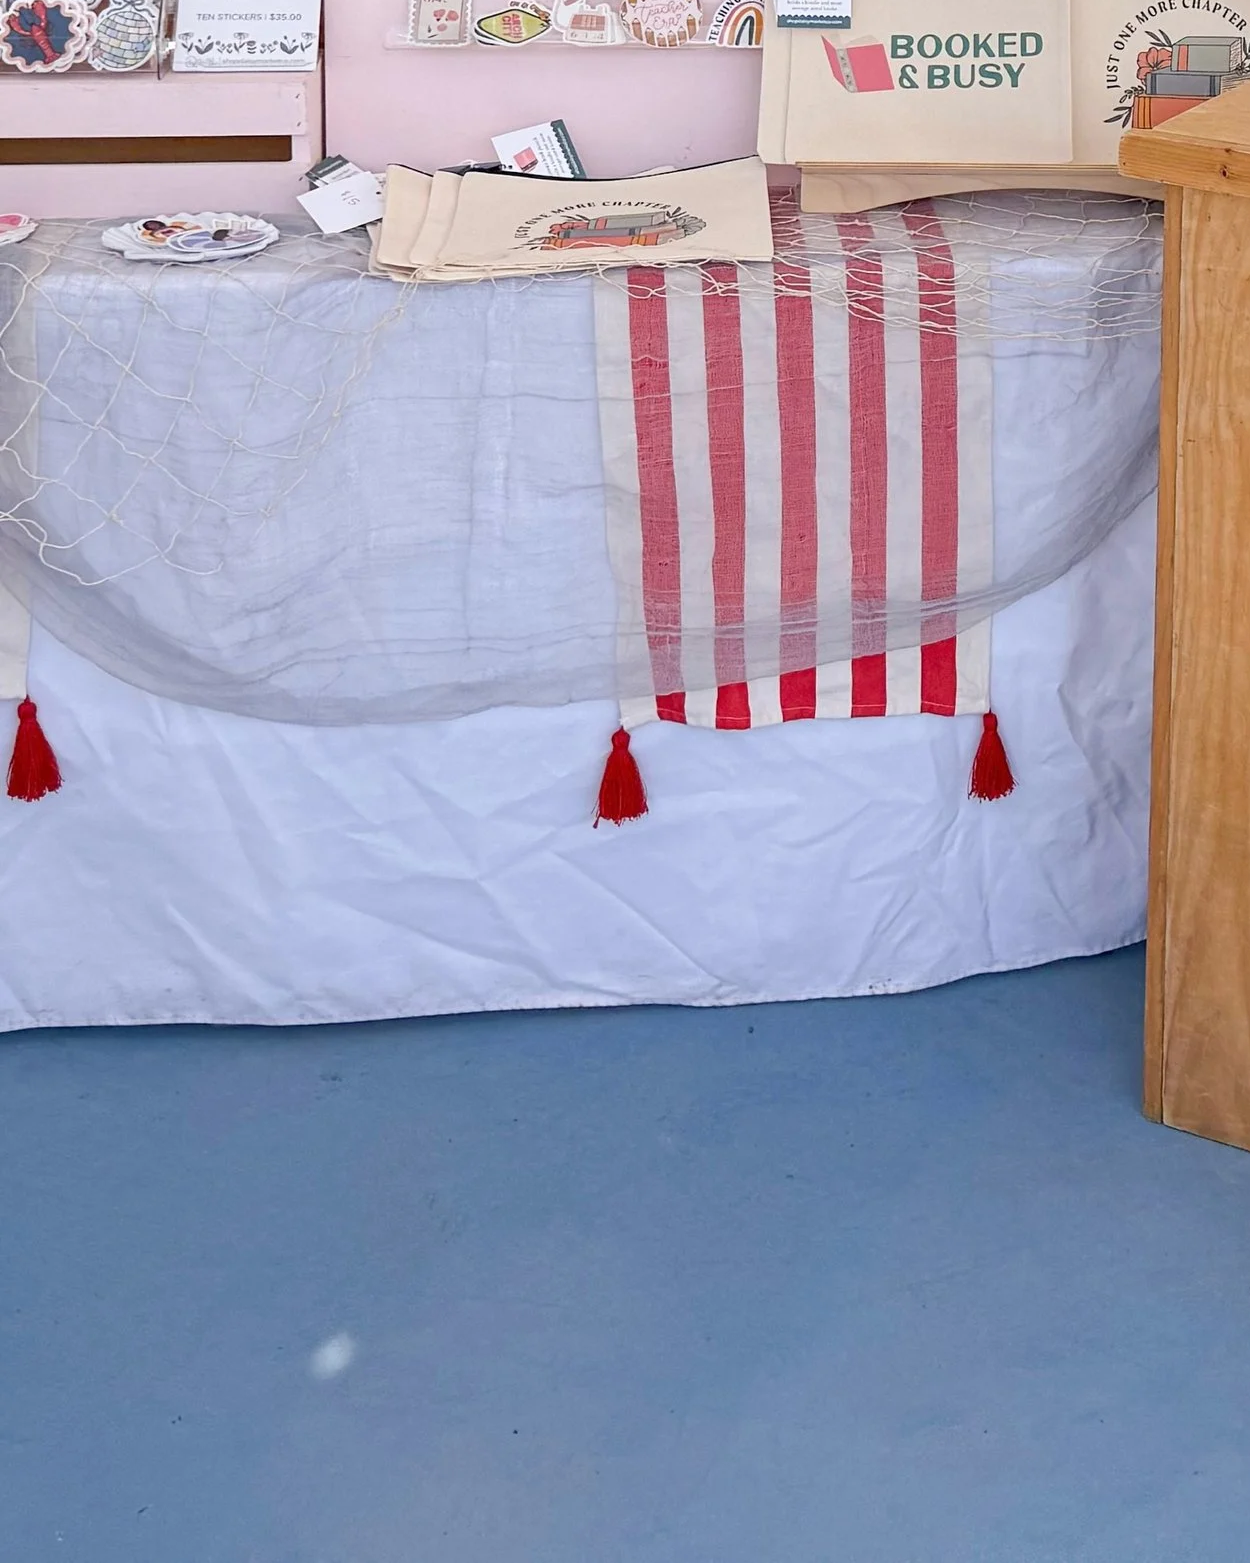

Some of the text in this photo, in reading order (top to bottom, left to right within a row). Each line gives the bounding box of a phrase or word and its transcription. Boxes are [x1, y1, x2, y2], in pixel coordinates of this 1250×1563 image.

[196, 13, 302, 21] TEN STICKERS $35.00
[890, 32, 1043, 59] BOOKED
[1113, 22, 1137, 51] ONE
[898, 63, 1025, 89] & BUSY
[1106, 54, 1121, 89] JUST
[551, 202, 596, 214] MORE
[602, 201, 672, 210] CHAPTER
